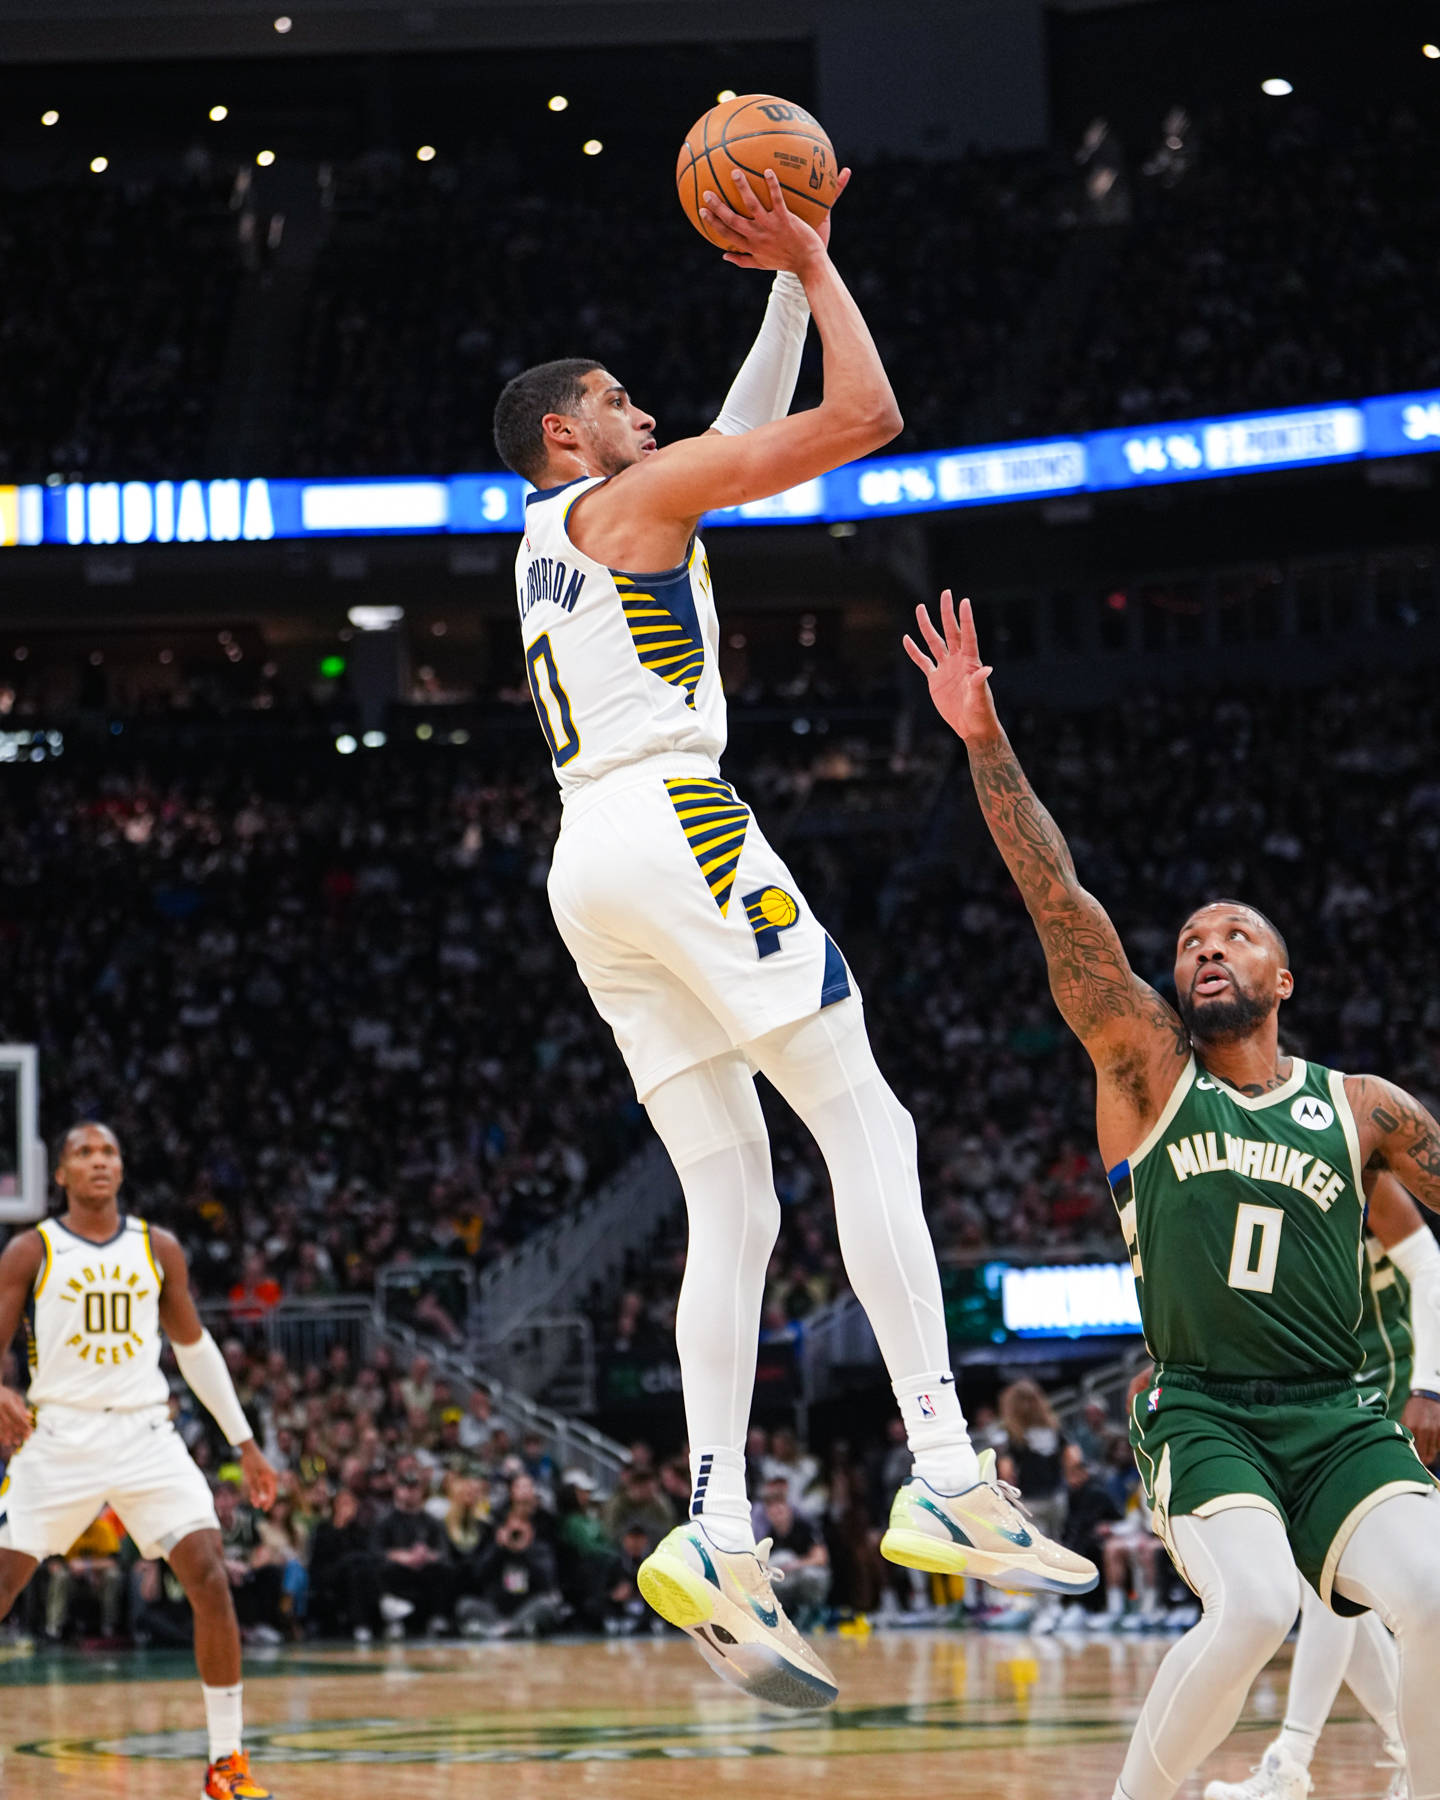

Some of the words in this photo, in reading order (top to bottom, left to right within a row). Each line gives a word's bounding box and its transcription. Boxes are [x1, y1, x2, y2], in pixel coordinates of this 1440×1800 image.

[66, 477, 275, 545] INDIANA
[1166, 1131, 1346, 1213] MILWAUKEE
[1227, 1202, 1285, 1294] 0
[60, 1264, 150, 1303] INDIANA
[84, 1291, 132, 1334] 00
[65, 1332, 144, 1365] PACERS
